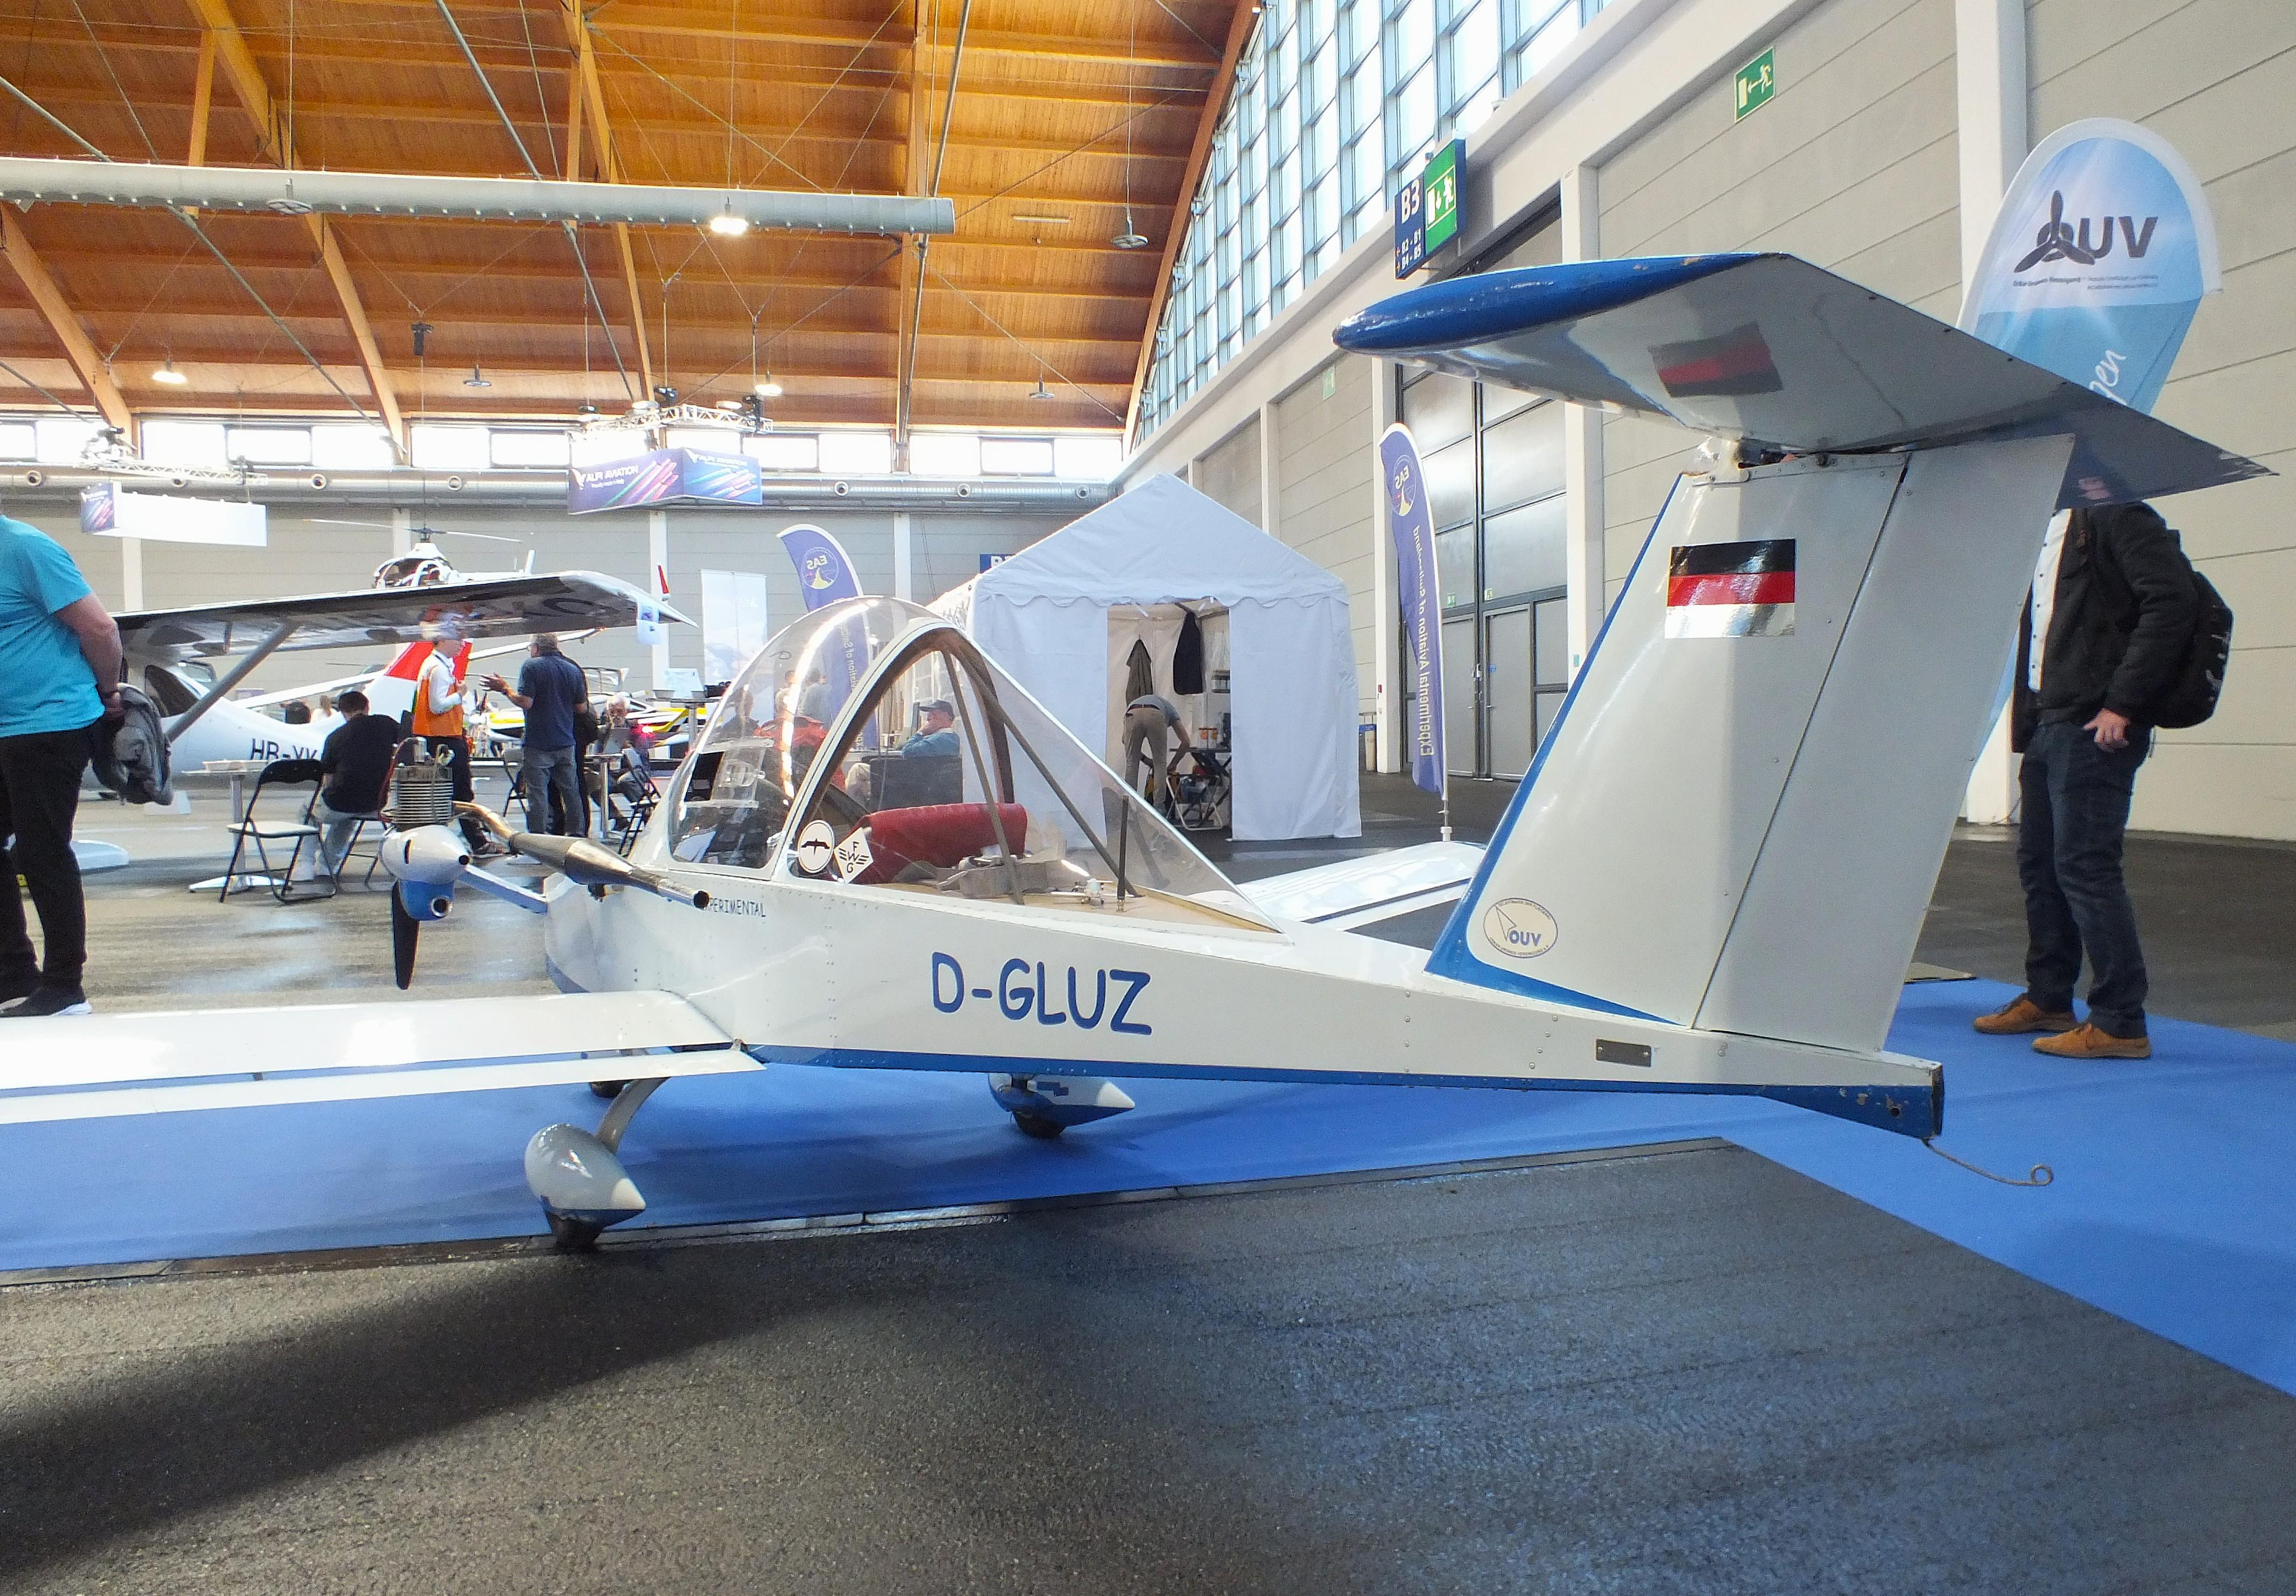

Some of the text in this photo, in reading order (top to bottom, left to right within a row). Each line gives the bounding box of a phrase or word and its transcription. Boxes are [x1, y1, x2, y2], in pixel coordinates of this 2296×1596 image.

[1401, 179, 1420, 223] B3
[1414, 228, 1421, 245] B1
[1401, 253, 1409, 270] B4
[1414, 243, 1421, 260] B5
[586, 465, 639, 483] ALPI AVIATION
[705, 898, 766, 917] PERIMENTAL
[1509, 930, 1541, 947] OUV
[932, 951, 1152, 1035] D-GLUZ
